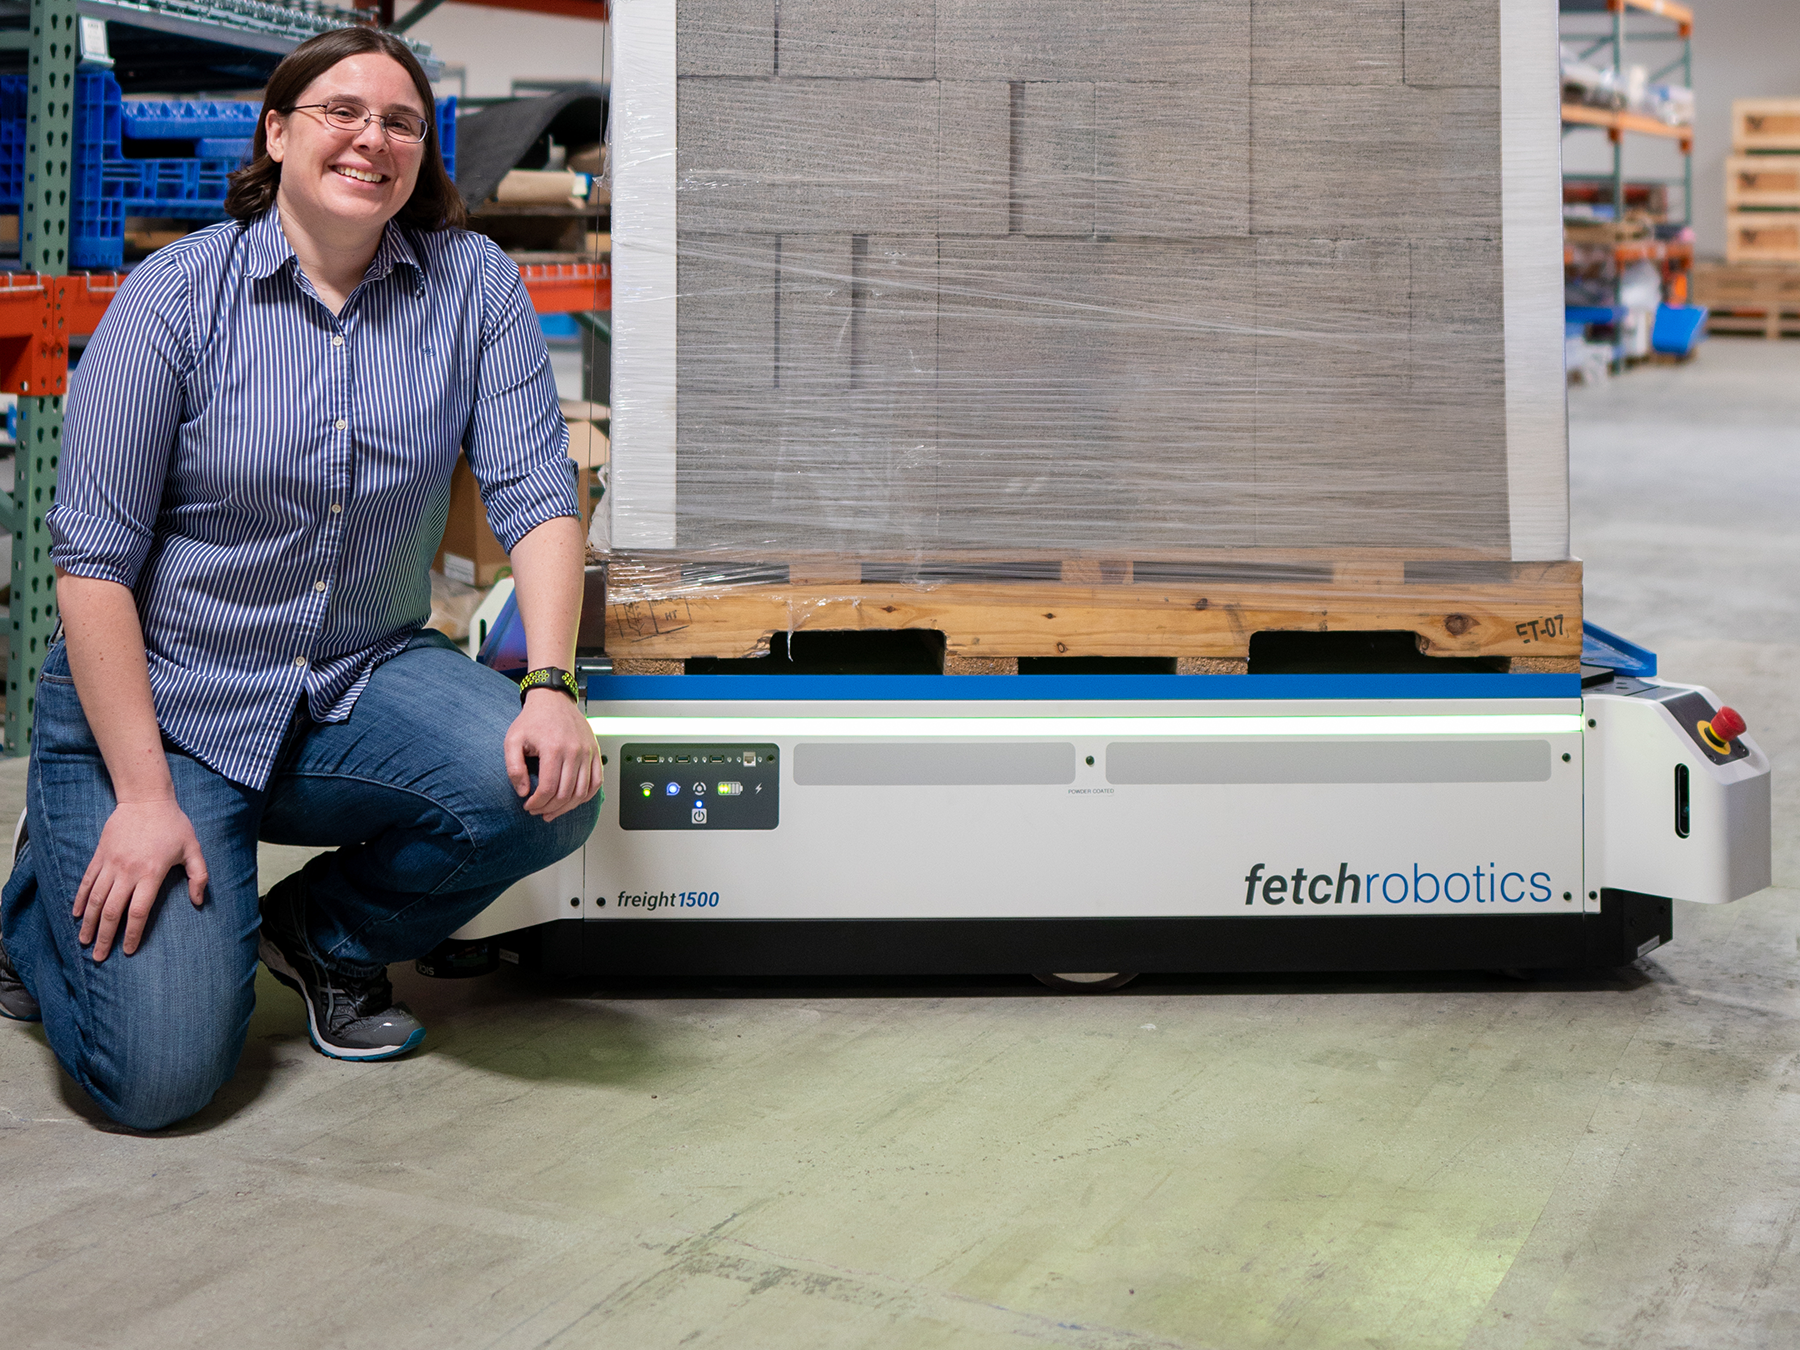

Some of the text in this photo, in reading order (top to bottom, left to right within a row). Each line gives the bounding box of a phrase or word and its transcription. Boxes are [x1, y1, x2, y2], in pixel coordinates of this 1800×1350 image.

[664, 609, 678, 622] HT
[1515, 614, 1564, 644] ET-07
[1244, 861, 1553, 906] fetchrobotics
[617, 890, 720, 912] freight1500
